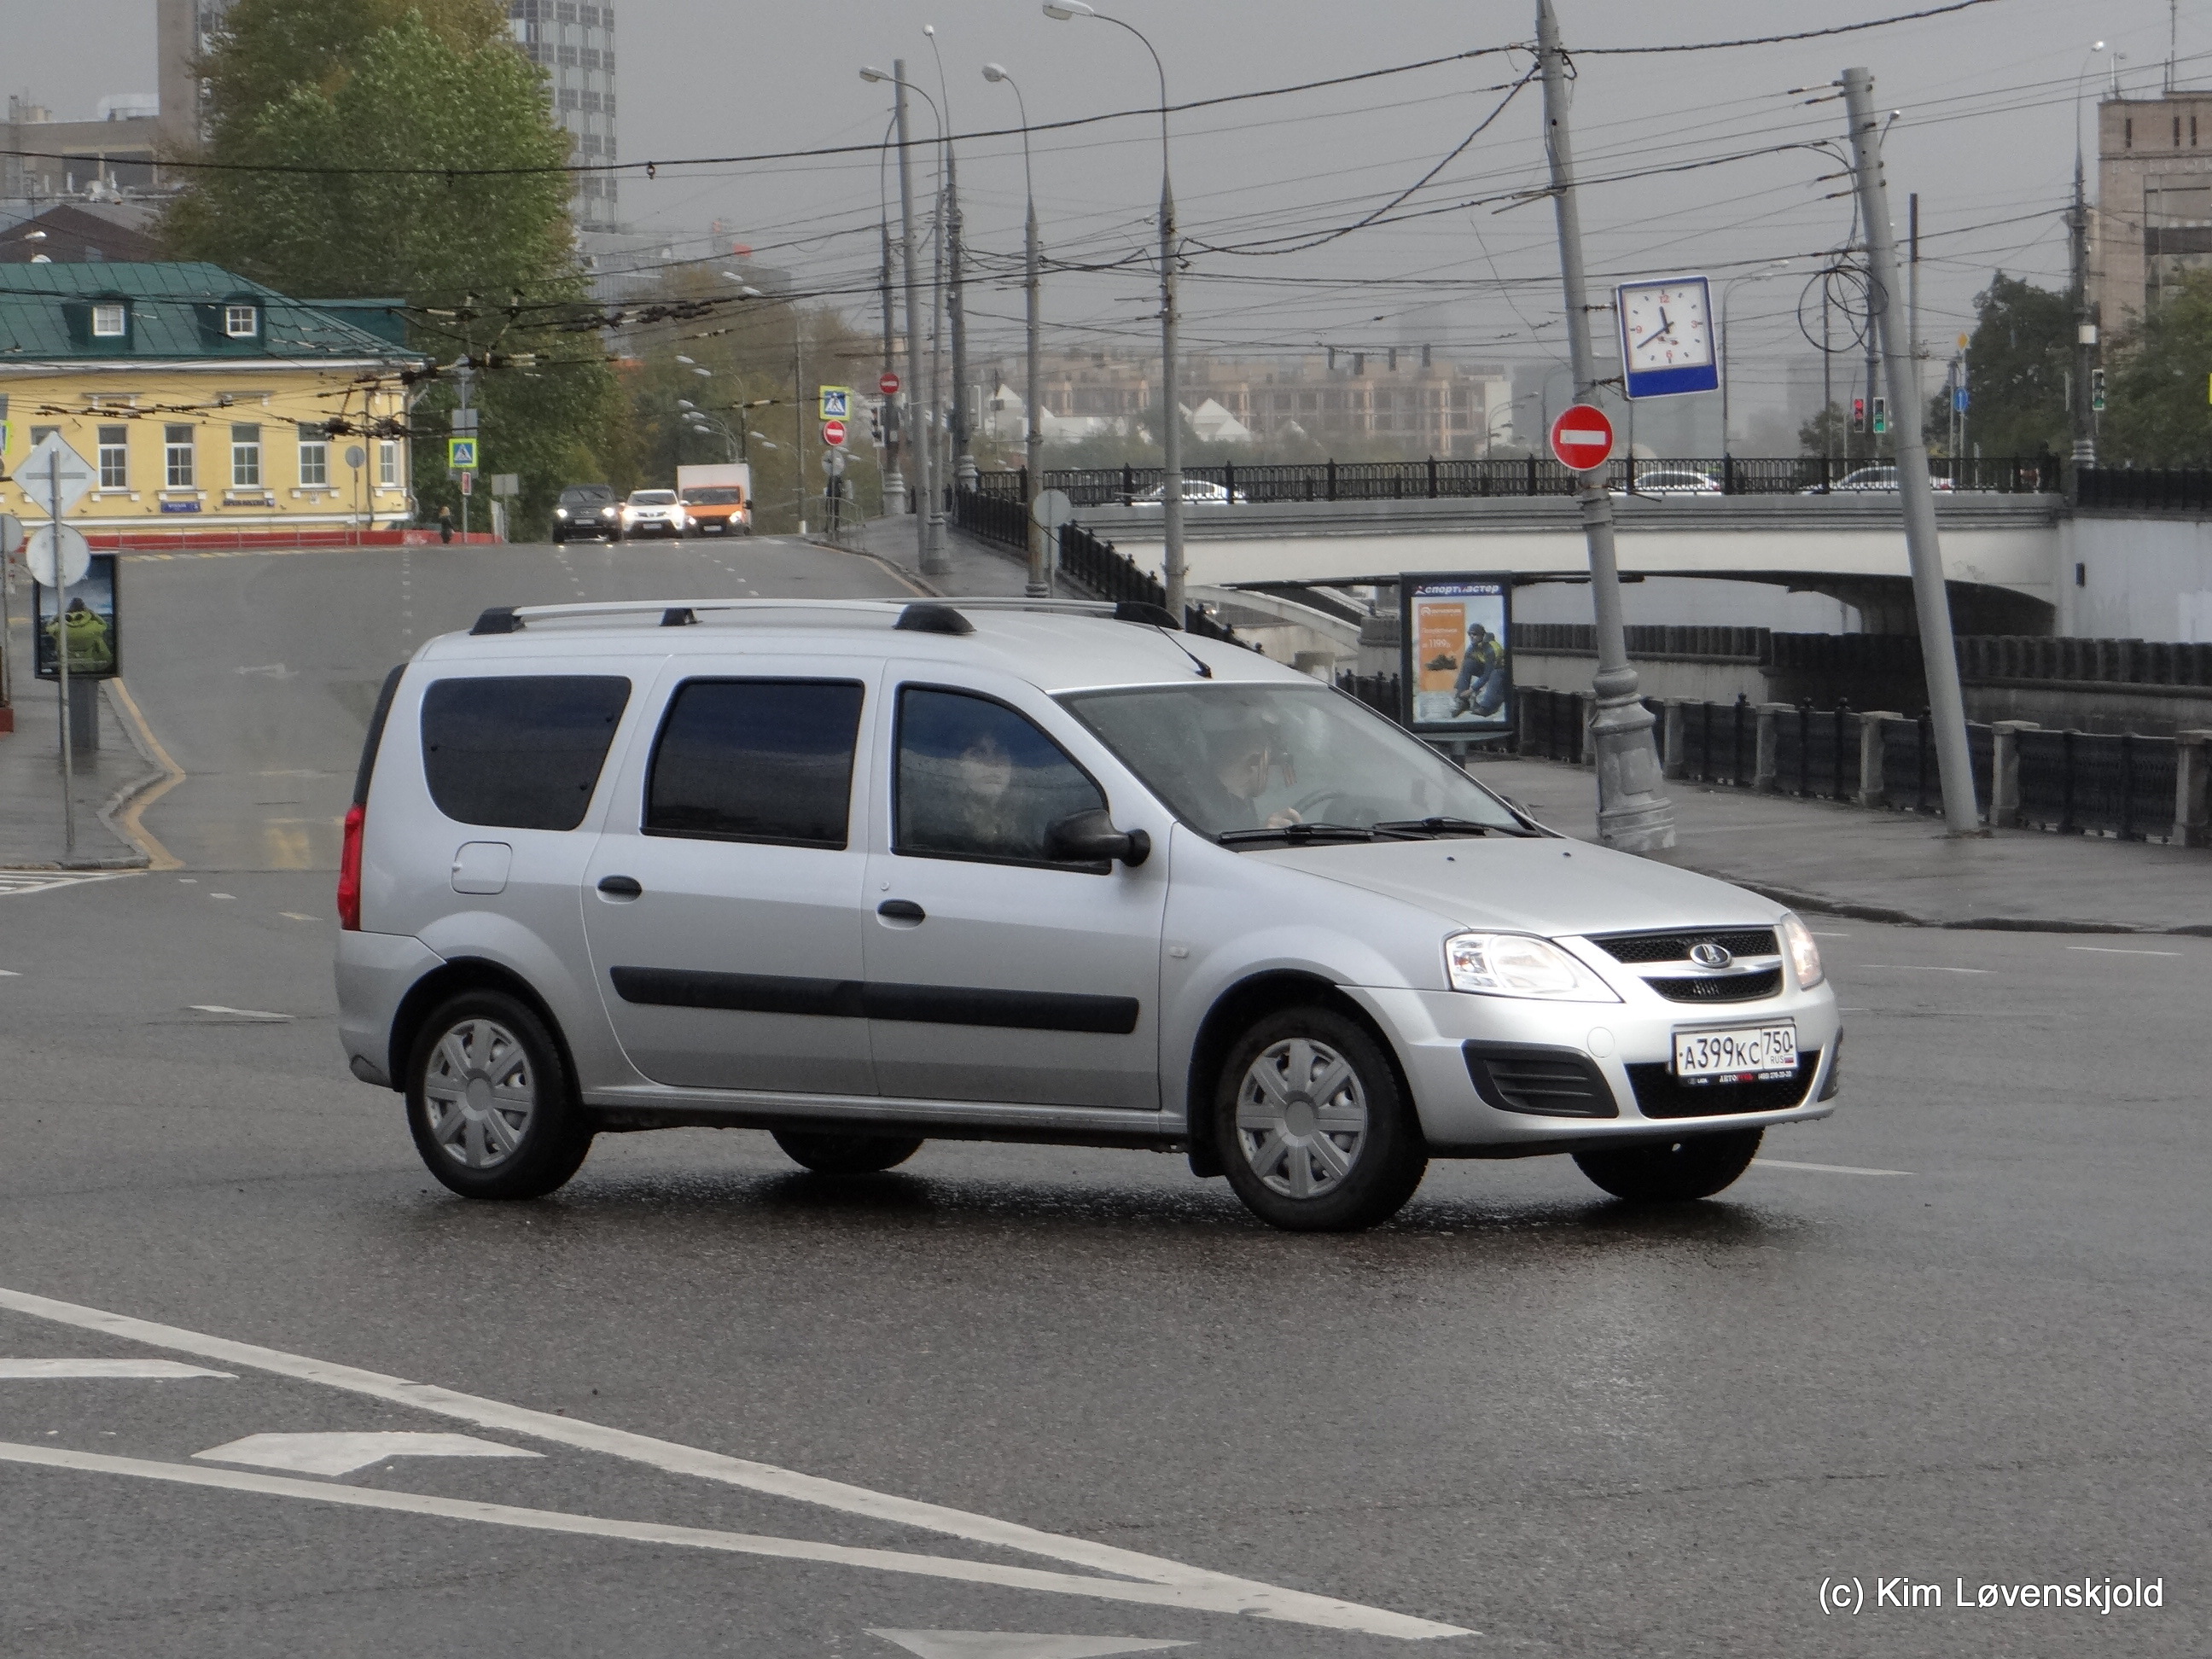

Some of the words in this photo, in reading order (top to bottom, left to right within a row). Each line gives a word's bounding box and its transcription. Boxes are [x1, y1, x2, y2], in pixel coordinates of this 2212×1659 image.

[1659, 294, 1669, 304] 12
[1691, 320, 1698, 329] 3
[1635, 325, 1643, 334] 9
[1666, 350, 1673, 358] 6
[1763, 1030, 1791, 1056] 750
[1770, 1056, 1784, 1064] RUS
